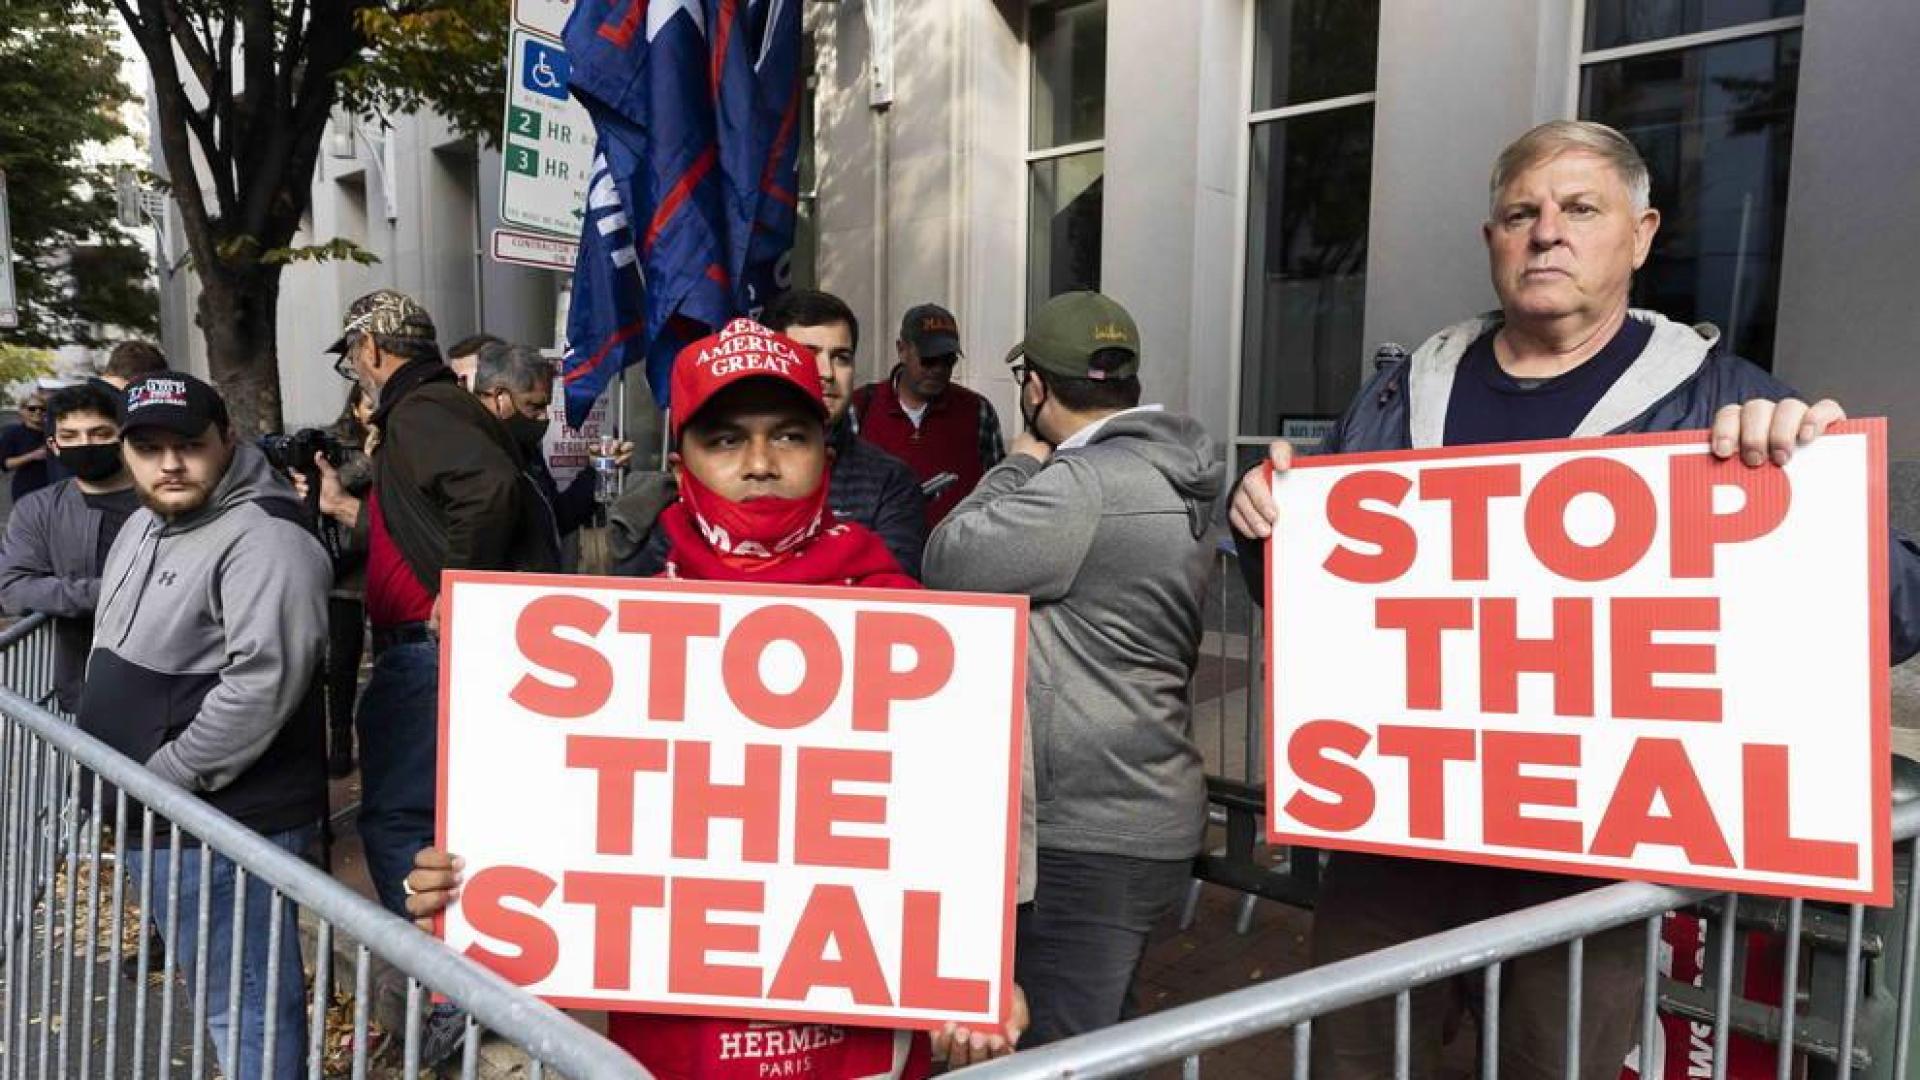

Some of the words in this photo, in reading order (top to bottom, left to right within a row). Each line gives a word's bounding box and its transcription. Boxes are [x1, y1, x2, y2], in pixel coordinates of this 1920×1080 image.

[518, 150, 529, 170] 3
[545, 156, 570, 180] HR
[519, 112, 531, 133] 2
[548, 120, 572, 144] HR
[696, 334, 802, 366] AMERICA
[711, 354, 791, 377] GREAT
[1322, 453, 1792, 583] STOP
[509, 594, 956, 732] STOP
[1375, 596, 1723, 723] THE
[565, 734, 893, 870] THE
[1283, 719, 1859, 881] STEAL
[461, 865, 991, 1014] STEAL
[759, 1056, 812, 1078] PARIS
